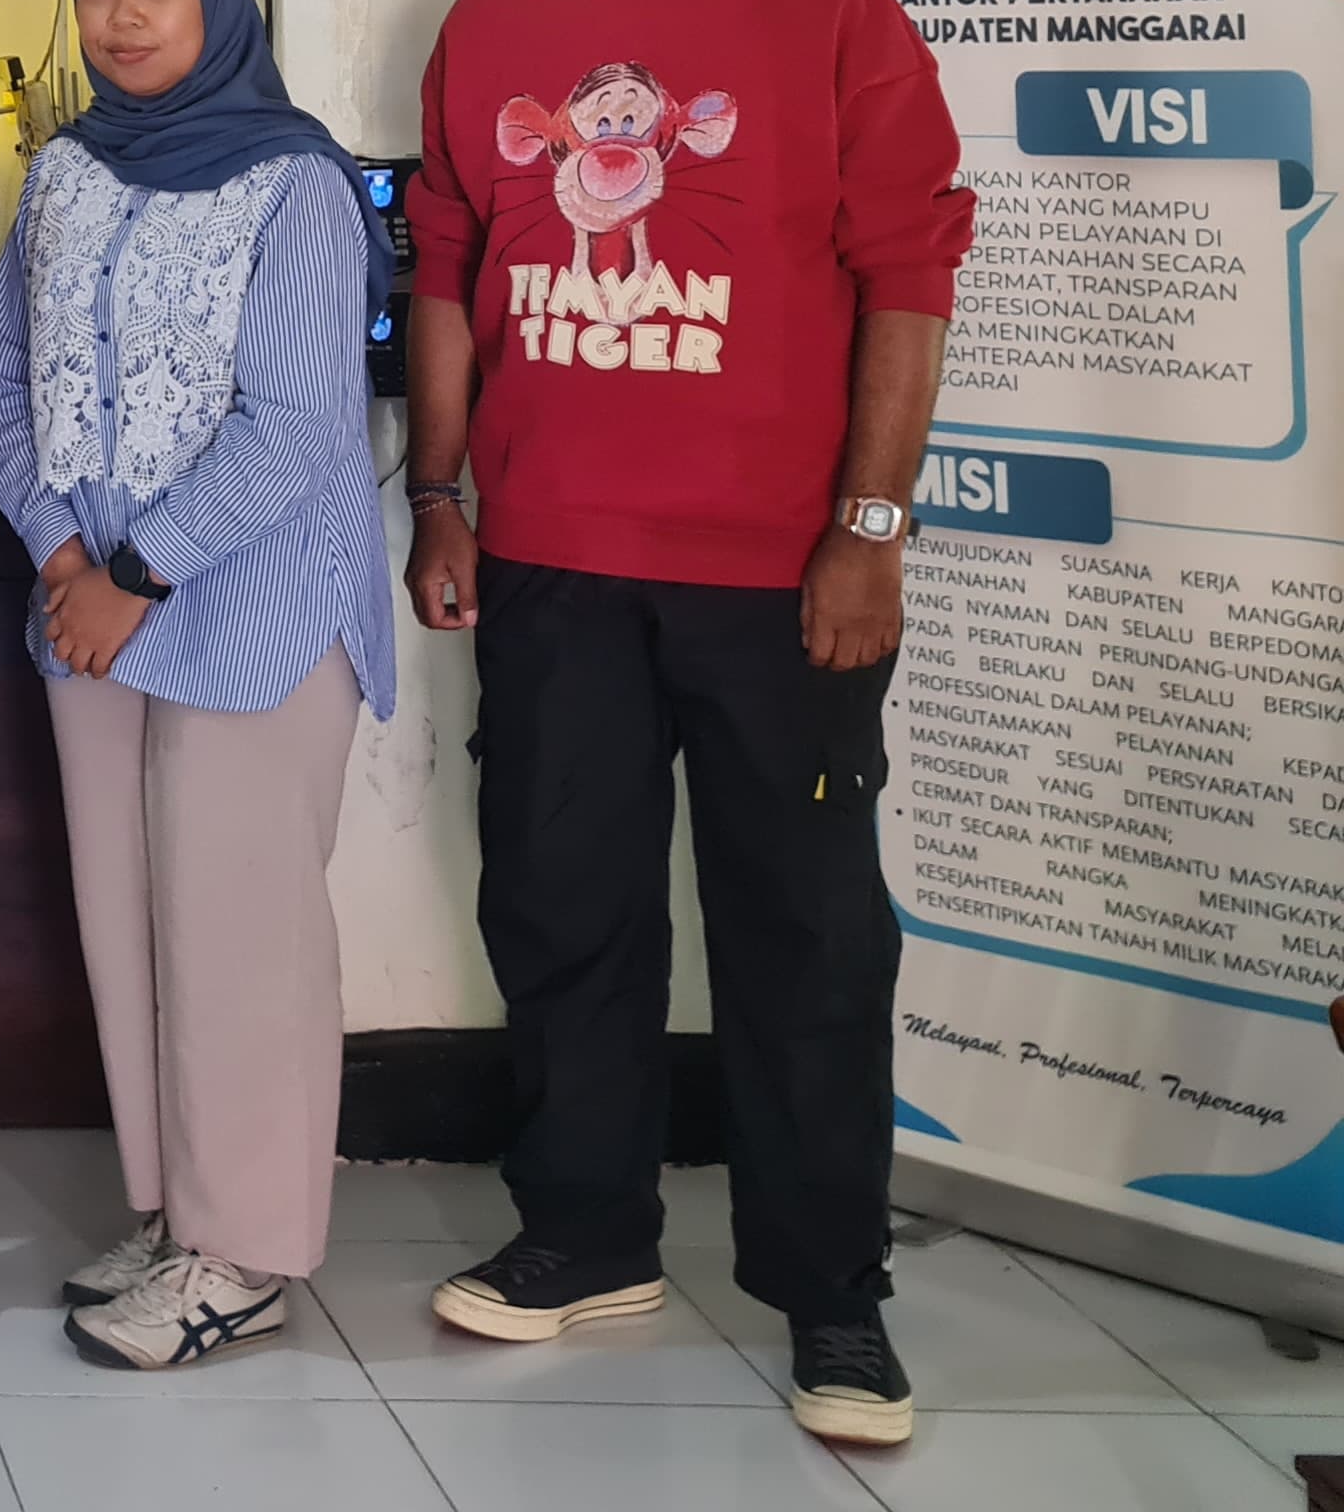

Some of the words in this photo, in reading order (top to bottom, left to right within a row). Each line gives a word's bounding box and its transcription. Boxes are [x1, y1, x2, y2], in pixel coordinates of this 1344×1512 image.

[1047, 13, 1246, 43] MANGGARAI
[1087, 88, 1209, 145] VISI
[949, 169, 1023, 189] DIKAN
[1031, 170, 1131, 192] KANTOR
[977, 195, 1030, 215] HAN
[1036, 196, 1105, 217] YANG
[1112, 199, 1210, 221] MAMPU
[969, 245, 1135, 270] PERTANAHAN
[1141, 252, 1247, 275] SECARA
[975, 221, 1031, 240] IKAN
[1039, 222, 1186, 246] PELAYANAN
[1196, 228, 1222, 248] DI
[953, 294, 1101, 320] ROFESIONAL
[1107, 302, 1196, 326] DALAM
[957, 270, 1062, 295] CERMAT,
[1067, 274, 1238, 301] TRANSPARAN
[520, 314, 724, 374] TIGER
[944, 344, 1075, 370] AHTERAAN
[1083, 353, 1254, 383] MASYARAKAT
[978, 321, 1175, 352] MENINGKATKAN
[915, 453, 1009, 515] MISI
[903, 562, 1026, 595] PERTANAHAN
[1067, 583, 1184, 615] KABUPATEN
[1228, 603, 1344, 634] MANGGAR
[904, 536, 1033, 568] MEWUJUDKAN
[1060, 554, 1153, 582] SUASANA
[1180, 569, 1241, 594] KERJA
[1272, 579, 1344, 605] KANTO
[904, 589, 954, 613] YANG
[966, 598, 1051, 625] NYAMAN
[1065, 610, 1109, 633] DAN
[1121, 617, 1194, 645] SELALU
[1210, 630, 1344, 664] BERPEDOMA
[905, 616, 954, 639] PADA
[967, 626, 1083, 657] PERATURAN
[1099, 643, 1344, 694] PERUNDANG-UNDANGA
[905, 643, 957, 667] YANG
[979, 655, 1066, 683] BERLAKU
[1092, 670, 1135, 694] DAN
[1159, 681, 1235, 708] SELALU
[908, 671, 1045, 708] PROFESSIONAL
[1050, 693, 1120, 719] DALAM
[1127, 704, 1253, 742] PELAYANAN;
[908, 698, 1072, 740] MENGUTAMAKAN
[1115, 731, 1234, 766] PELAYANAN
[909, 726, 1032, 761] MASYARAKAT
[1055, 749, 1123, 776] SESUAI
[1147, 764, 1294, 805] PERSYARATAN
[910, 751, 1010, 785] PROSEDUR
[1037, 775, 1094, 800] YANG
[1123, 789, 1255, 828] DITENTUKAN
[1288, 816, 1344, 842] SECA
[911, 779, 985, 808] CERMAT
[990, 794, 1032, 817] DAN
[1035, 801, 1174, 845] TRANSPARAN;
[912, 807, 953, 828] IKUT
[960, 816, 1033, 845] SECARA
[1039, 832, 1094, 854] AKTIF
[1102, 841, 1220, 881] MEMBANTU
[1229, 866, 1344, 903] MASYARAK
[914, 834, 978, 861] DALAM
[1046, 860, 1130, 890] RANGKA
[1199, 890, 1344, 932] MENINGKATK
[915, 862, 1064, 906] KESEJAHTERAAN
[1104, 898, 1239, 942] MASYARAKAT
[1282, 934, 1344, 963] MELA
[916, 888, 1084, 938] PENSERTIPIKATAN
[1087, 924, 1157, 953] TANAH
[1162, 939, 1217, 968] MILIK
[1224, 953, 1344, 992] MASYARAK
[1159, 1074, 1288, 1127] Terpercaya
